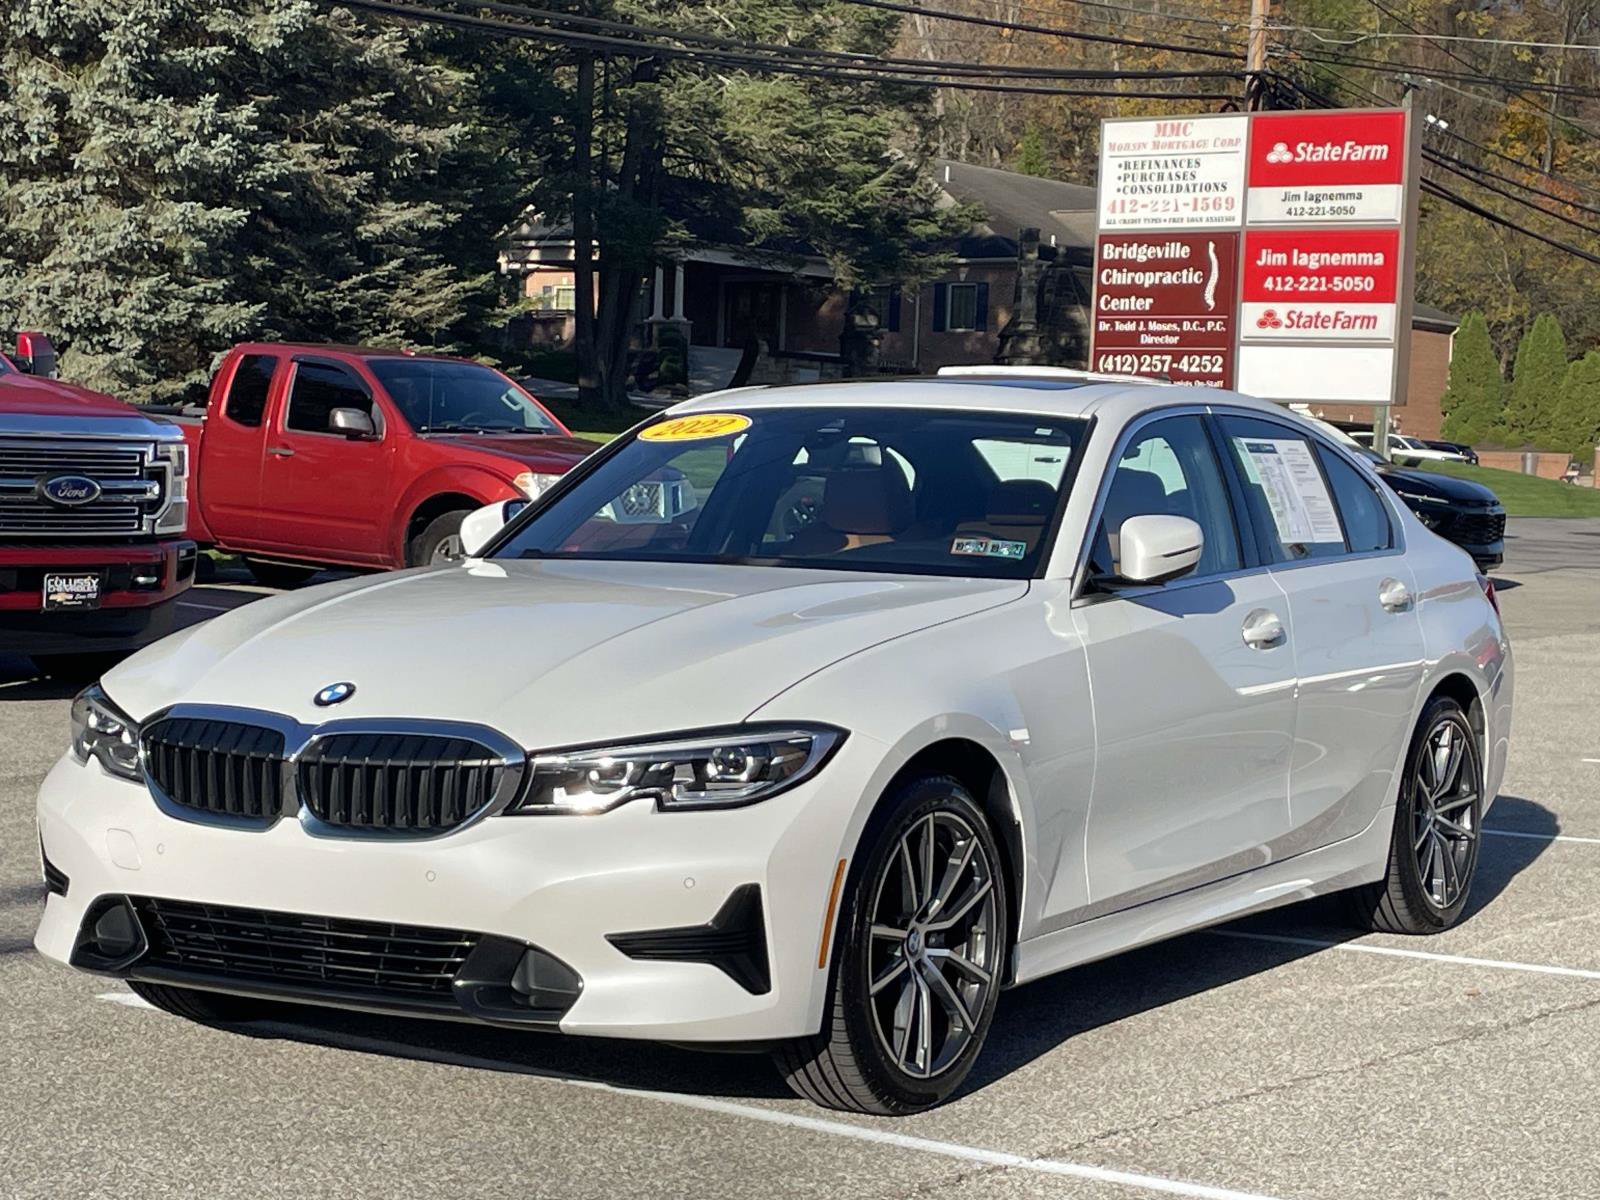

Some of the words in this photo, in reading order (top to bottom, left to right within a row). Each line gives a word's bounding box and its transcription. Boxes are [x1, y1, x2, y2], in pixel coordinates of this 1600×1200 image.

[1154, 122, 1194, 137] MMC
[1151, 139, 1210, 150] MORTGAGE
[1123, 158, 1201, 170] REFINANCES
[1123, 171, 1196, 183] PURCHASES
[1122, 182, 1228, 195] CONSOLIDATIONS
[1281, 191, 1301, 202] Jim
[1303, 190, 1363, 204] Iagnemma
[1107, 196, 1235, 214] 412-221-1569
[1286, 206, 1356, 217] 412-221-5050
[1102, 242, 1190, 262] Bridgeville
[1256, 249, 1287, 266] Jim
[1292, 249, 1385, 270] Iagnemma
[1101, 267, 1204, 288] Chiropractic
[1263, 276, 1375, 292] 412-221-5050
[1099, 294, 1153, 311] Center
[1098, 321, 1113, 331] Dr.
[1114, 321, 1136, 331] Todd
[1138, 321, 1147, 331] J.
[1140, 333, 1180, 344] Director
[652, 419, 737, 436] 2022
[57, 482, 88, 497] Ford
